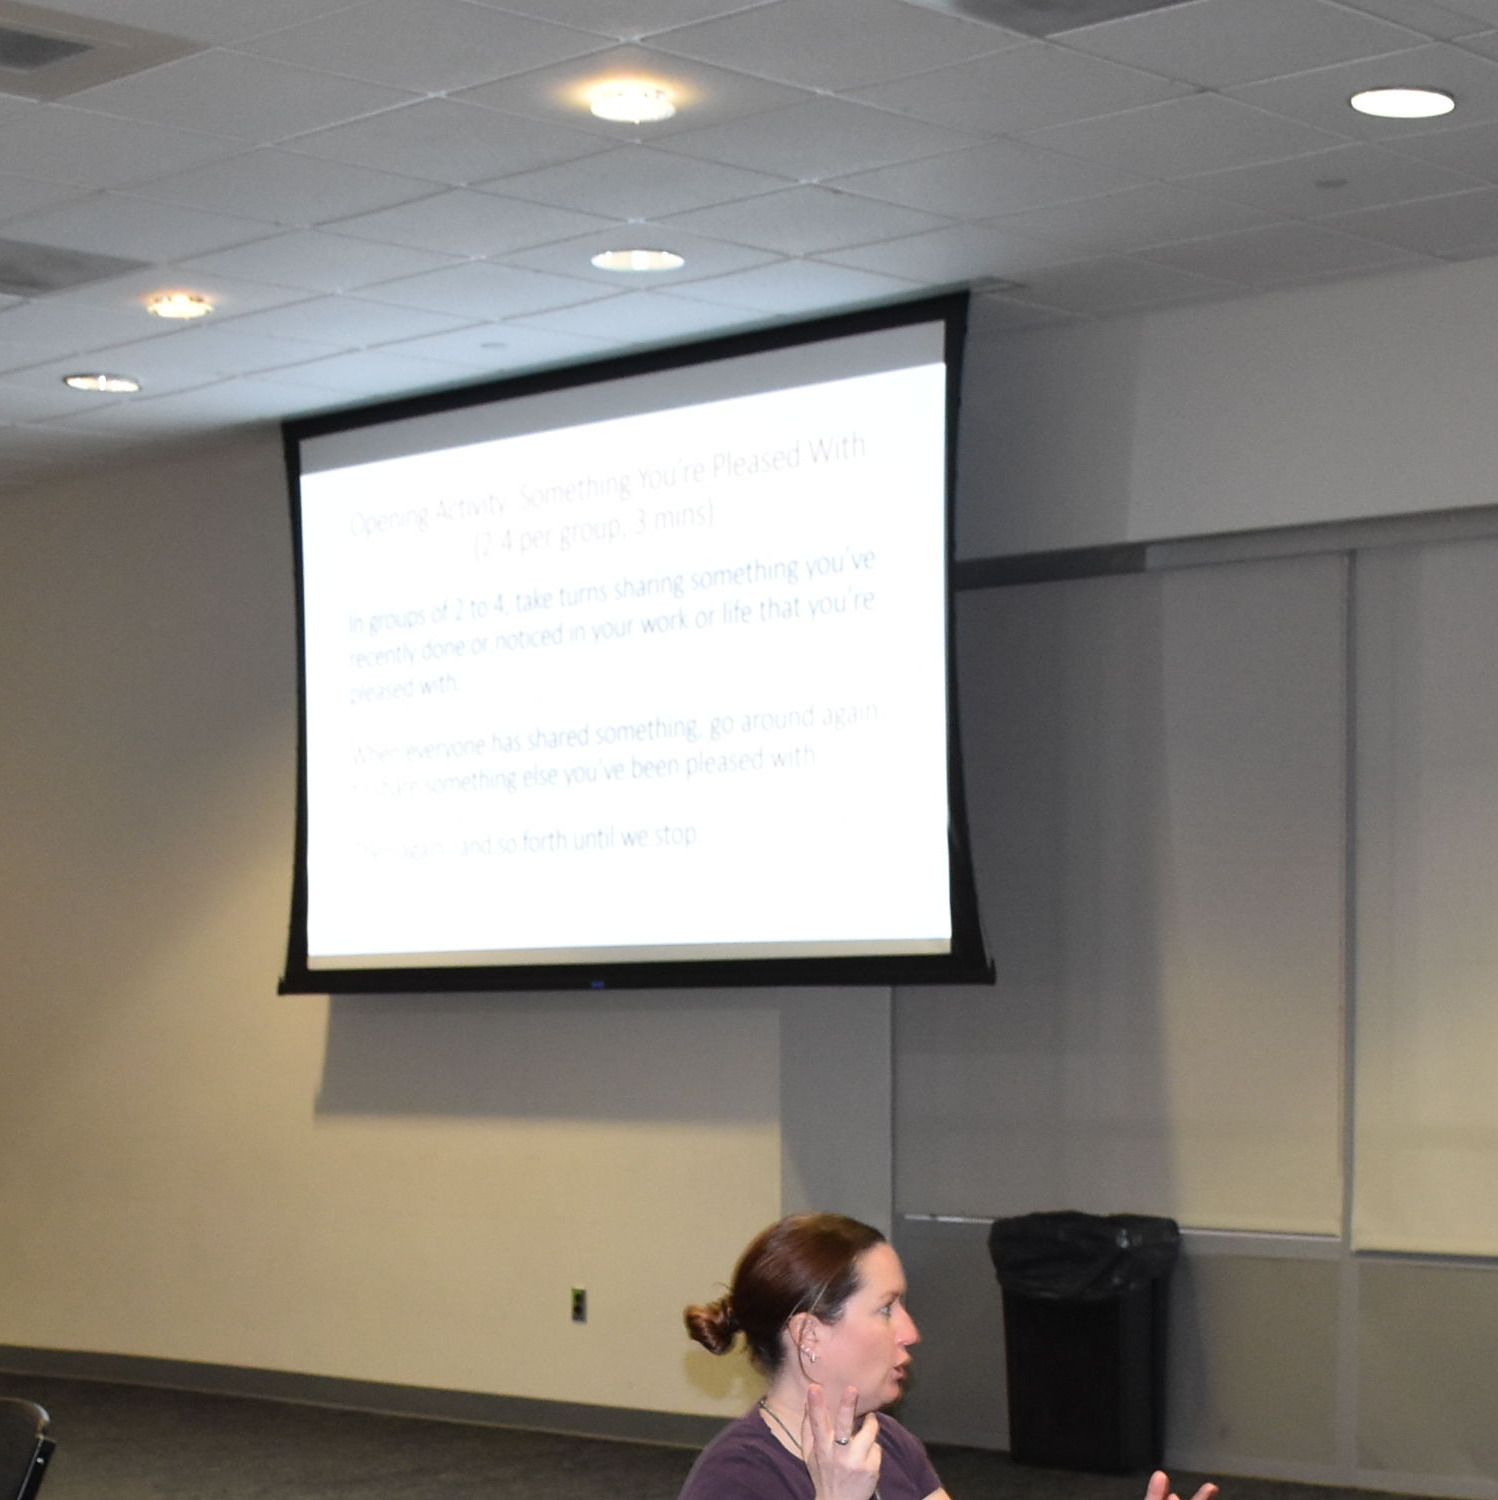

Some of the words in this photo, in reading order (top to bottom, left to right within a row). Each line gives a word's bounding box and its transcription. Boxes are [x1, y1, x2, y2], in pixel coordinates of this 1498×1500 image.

[349, 507, 429, 543] Opening
[519, 472, 632, 511] Something
[637, 456, 706, 490] You're
[712, 440, 800, 480] Pleased
[808, 428, 866, 464] With
[519, 526, 551, 557] per
[558, 516, 628, 552] group,
[635, 507, 646, 535] 3
[654, 496, 714, 530] mins)
[348, 612, 365, 634] In
[368, 607, 427, 638] groups
[430, 598, 450, 625] of
[454, 597, 465, 622] 2
[470, 598, 489, 620] to
[516, 586, 553, 614] take
[558, 583, 609, 609] turns
[613, 573, 686, 601] sharing
[691, 558, 800, 590] something
[805, 544, 876, 581] you've
[349, 642, 415, 669] recently
[420, 636, 467, 661] done
[470, 636, 489, 656] or
[495, 622, 564, 652] noticed
[568, 622, 587, 643] in
[591, 617, 634, 646] your
[639, 605, 688, 635] work
[693, 606, 716, 630] or
[722, 597, 753, 625] life
[758, 594, 801, 622] that
[807, 585, 876, 621] you're
[350, 678, 415, 706] pleased
[404, 735, 487, 763] everyone
[491, 731, 522, 754] has
[528, 721, 589, 752] shared
[595, 714, 703, 745] something,
[709, 714, 735, 743] go
[740, 703, 814, 733] around
[821, 701, 879, 732] again
[427, 767, 519, 796] something
[522, 761, 559, 789] else
[563, 757, 626, 790] you've
[631, 754, 680, 781] been
[685, 744, 764, 781] pleased
[459, 832, 492, 857] and
[497, 836, 519, 855] so
[522, 828, 568, 854] forth
[573, 824, 615, 853] until
[620, 827, 649, 848] we
